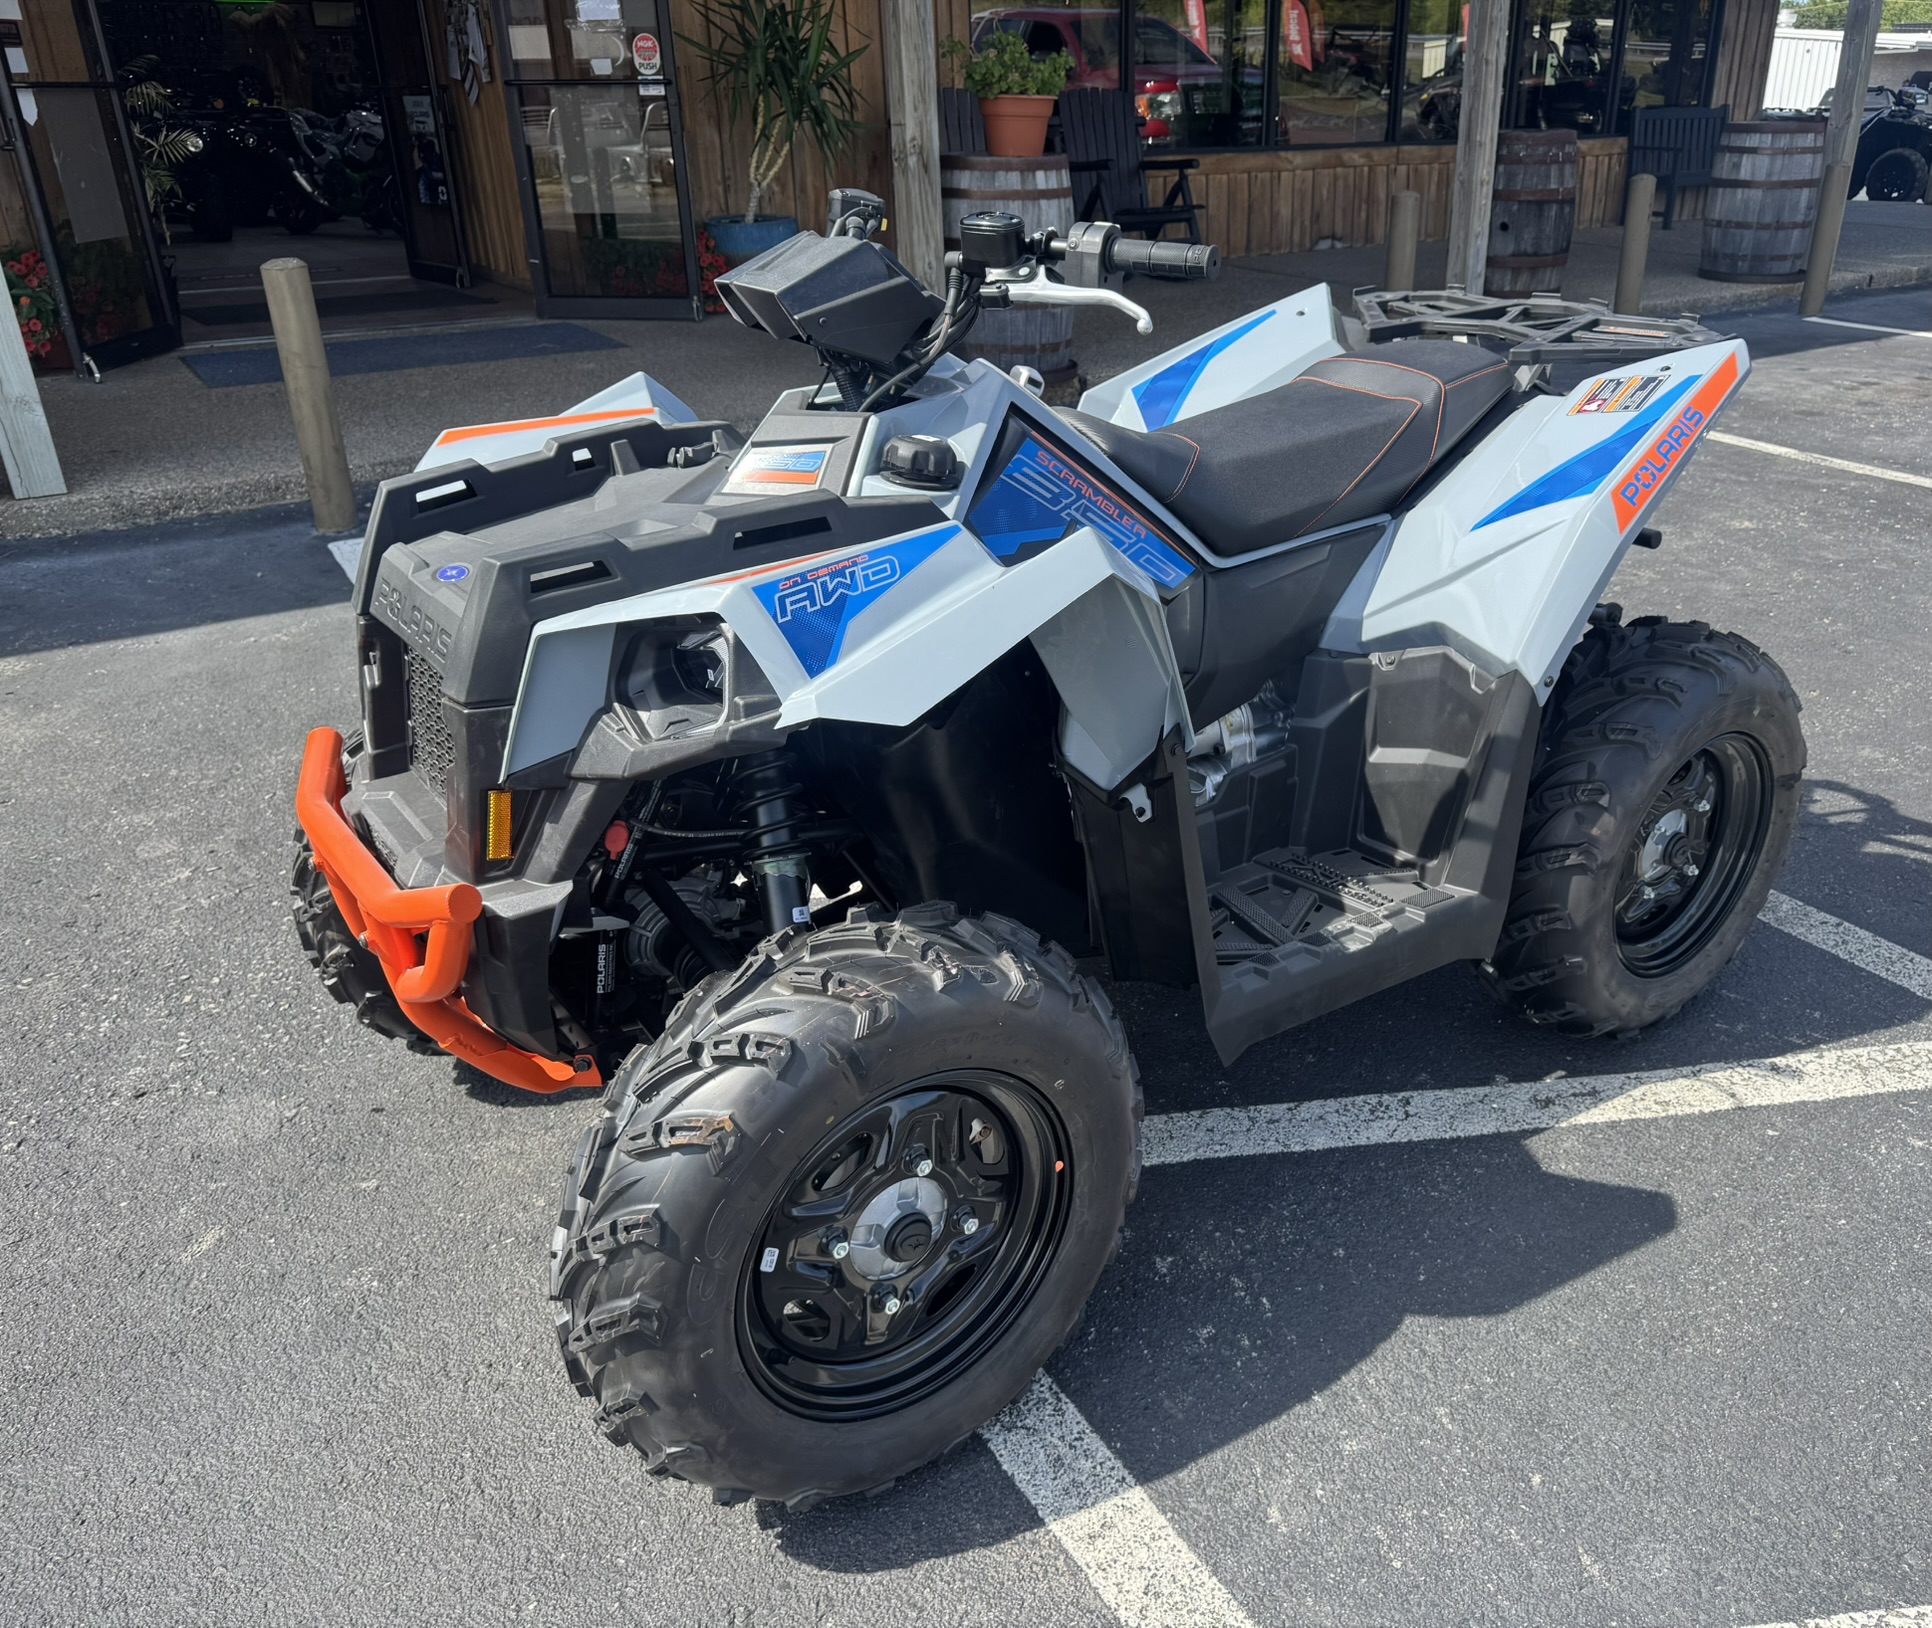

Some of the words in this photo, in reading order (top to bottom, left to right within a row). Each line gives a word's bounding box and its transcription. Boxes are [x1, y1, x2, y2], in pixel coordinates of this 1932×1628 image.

[638, 62, 658, 70] PUSH
[1620, 405, 1705, 507] POLARIS
[1034, 450, 1147, 540] SCRAMBLER
[774, 555, 900, 623] AWD
[779, 577, 802, 590] ON
[807, 554, 869, 580] DEMAND
[374, 576, 453, 664] POLARIS
[596, 943, 607, 994] POLARIS
